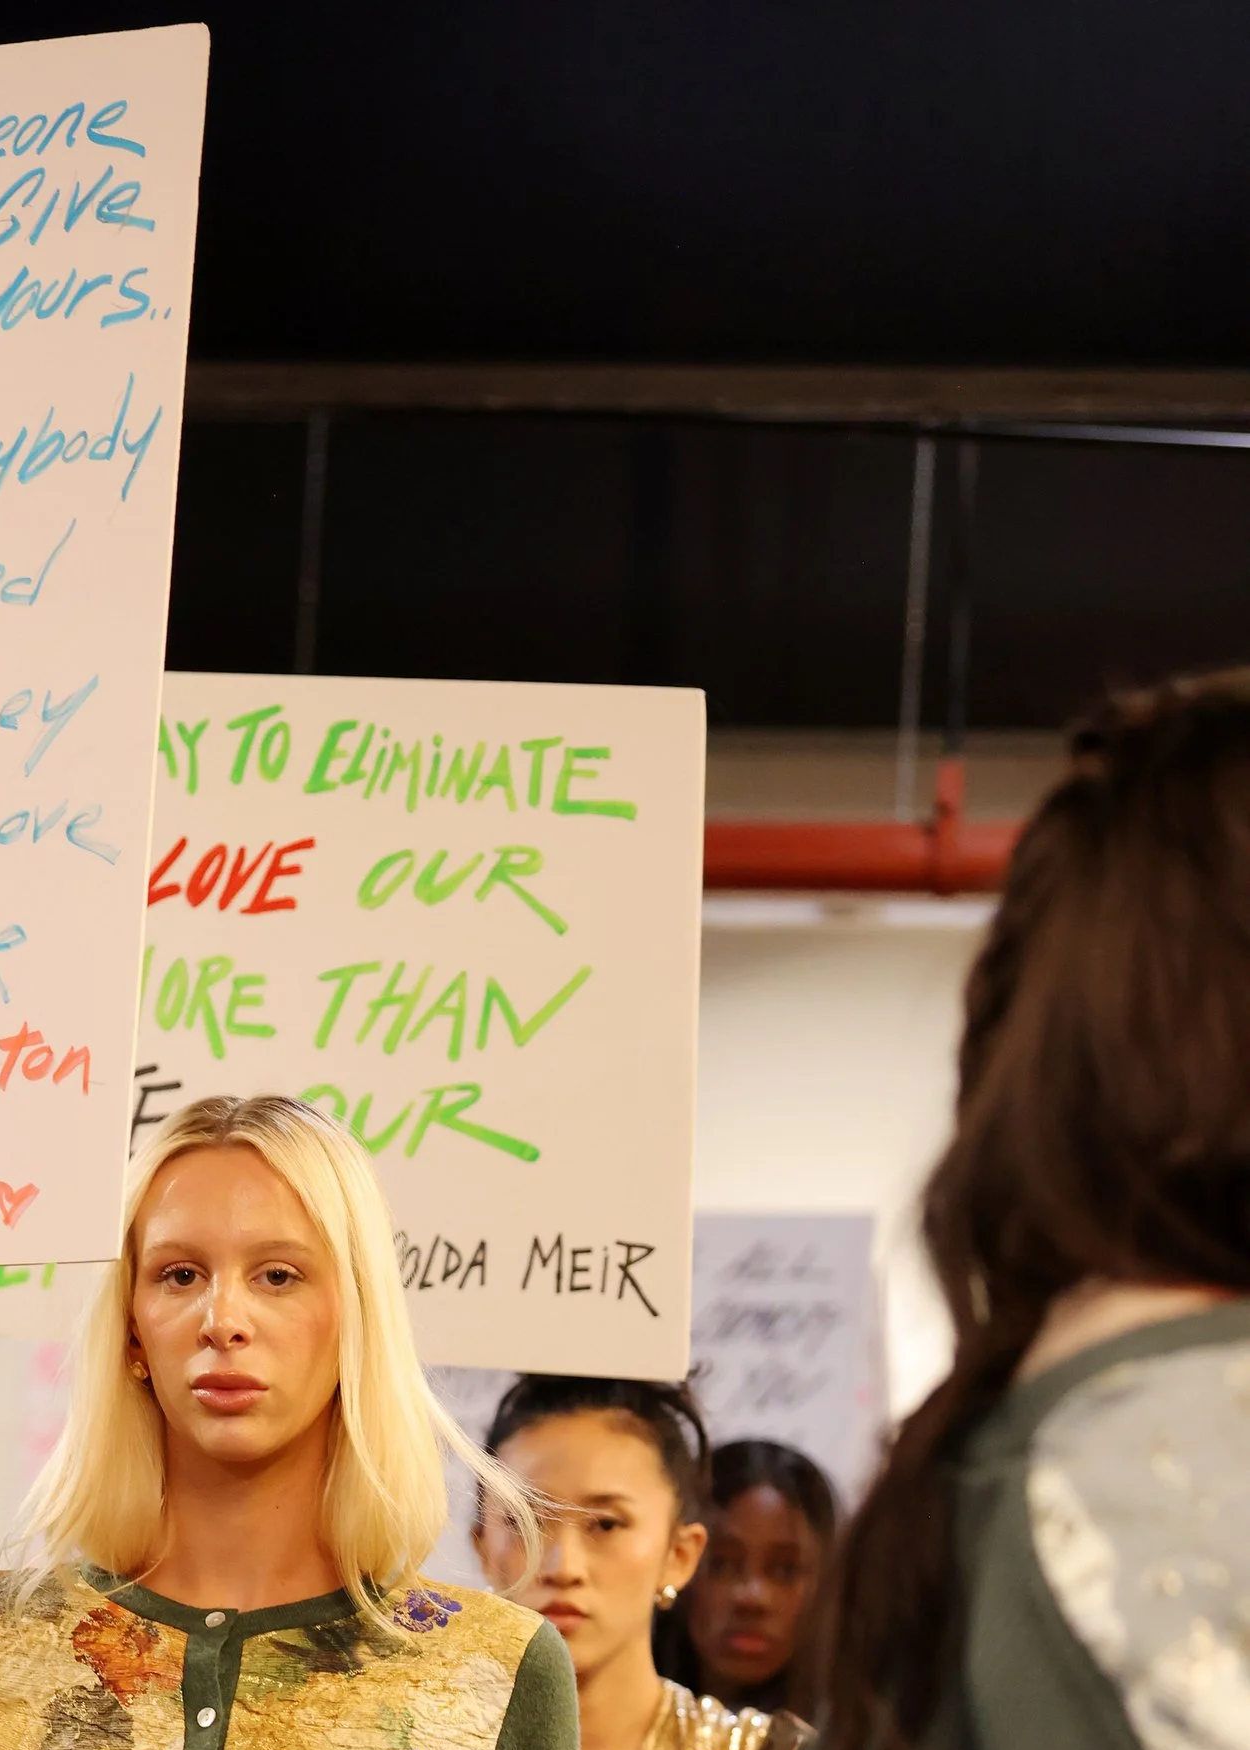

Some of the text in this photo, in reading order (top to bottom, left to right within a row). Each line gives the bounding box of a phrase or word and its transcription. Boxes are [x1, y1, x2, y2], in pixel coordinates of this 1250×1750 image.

[226, 703, 292, 785] TO
[147, 835, 569, 937] LOVE OUR
[139, 944, 594, 1063] ORE THAN
